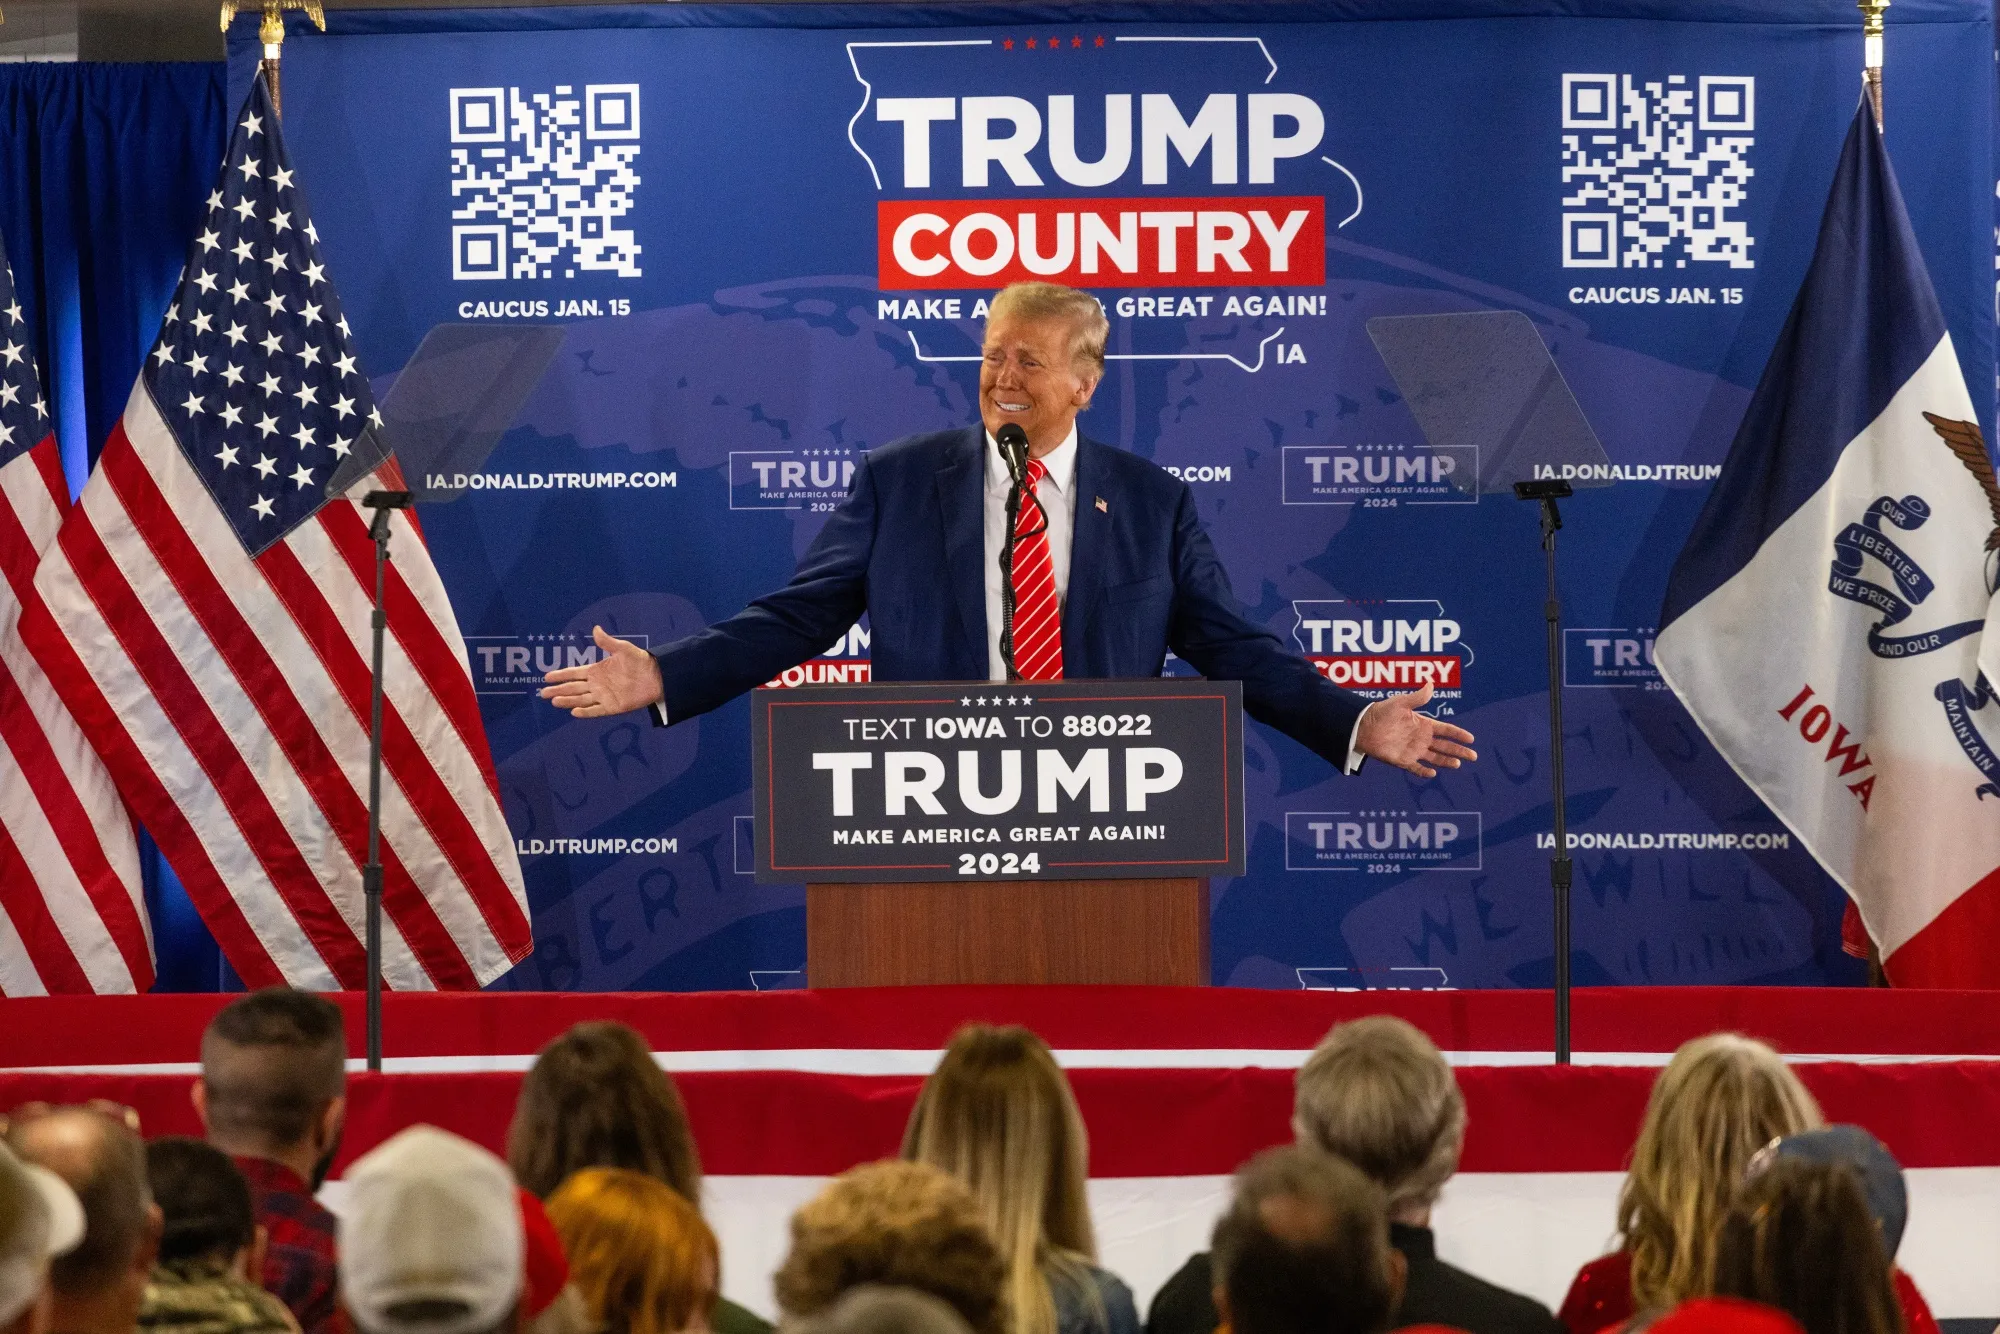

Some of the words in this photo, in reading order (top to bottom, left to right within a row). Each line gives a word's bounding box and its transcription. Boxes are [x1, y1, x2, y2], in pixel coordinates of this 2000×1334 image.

[876, 93, 1326, 188] TRUMP
[892, 210, 1310, 276] COUNTRY
[1568, 287, 1660, 304] CAUCUS
[1665, 287, 1716, 304] JAN.
[1720, 288, 1744, 304] 15
[458, 301, 549, 318] CAUCUS
[554, 300, 604, 317] JAN.
[608, 299, 631, 316] 15
[878, 298, 962, 320] MAKE
[1116, 296, 1214, 318] GREAT
[1222, 295, 1327, 317] AGAIN!
[1277, 343, 1307, 364] IA
[752, 460, 856, 488] TRU
[1305, 456, 1456, 483] TRUMP
[1534, 464, 1722, 481] IA.DONALDJTRUM
[426, 471, 677, 490] IA.DONALDJTRUMP.COM
[1416, 486, 1448, 494] AGAIN!
[810, 502, 837, 512] 202
[1363, 498, 1398, 507] 2024
[1881, 500, 1907, 525] OUR
[1849, 530, 1920, 585] LIBERTIES
[1832, 577, 1856, 595] WE
[1857, 586, 1897, 612] PRIZE
[1302, 620, 1461, 653] TRUMP
[1878, 642, 1904, 655] AND
[1906, 634, 1941, 653] OUR
[485, 676, 510, 684] MAKE
[513, 676, 546, 684] AMERIC
[1644, 681, 1670, 691] 202
[1433, 690, 1462, 698] GAIN!
[1443, 707, 1455, 715] IA
[843, 718, 917, 741] TEXT
[925, 716, 1006, 739] IOWA
[1014, 716, 1053, 738] TO
[1062, 714, 1152, 737] 88022
[1946, 698, 1995, 771] MAINTAIN
[1777, 683, 1878, 813] IOWA
[812, 747, 1184, 816] TRUMP
[833, 829, 894, 845] MAKE
[901, 827, 1001, 844] AMERICA
[1009, 826, 1080, 843] GREAT
[1088, 824, 1166, 842] AGAIN!
[1307, 822, 1459, 849] TRUMP
[1536, 833, 1789, 849] IADONALDJTRUMP.COM
[518, 838, 678, 854] LDJTRUMP.COM
[958, 852, 1041, 875] 2024
[1367, 864, 1401, 874] 2024
